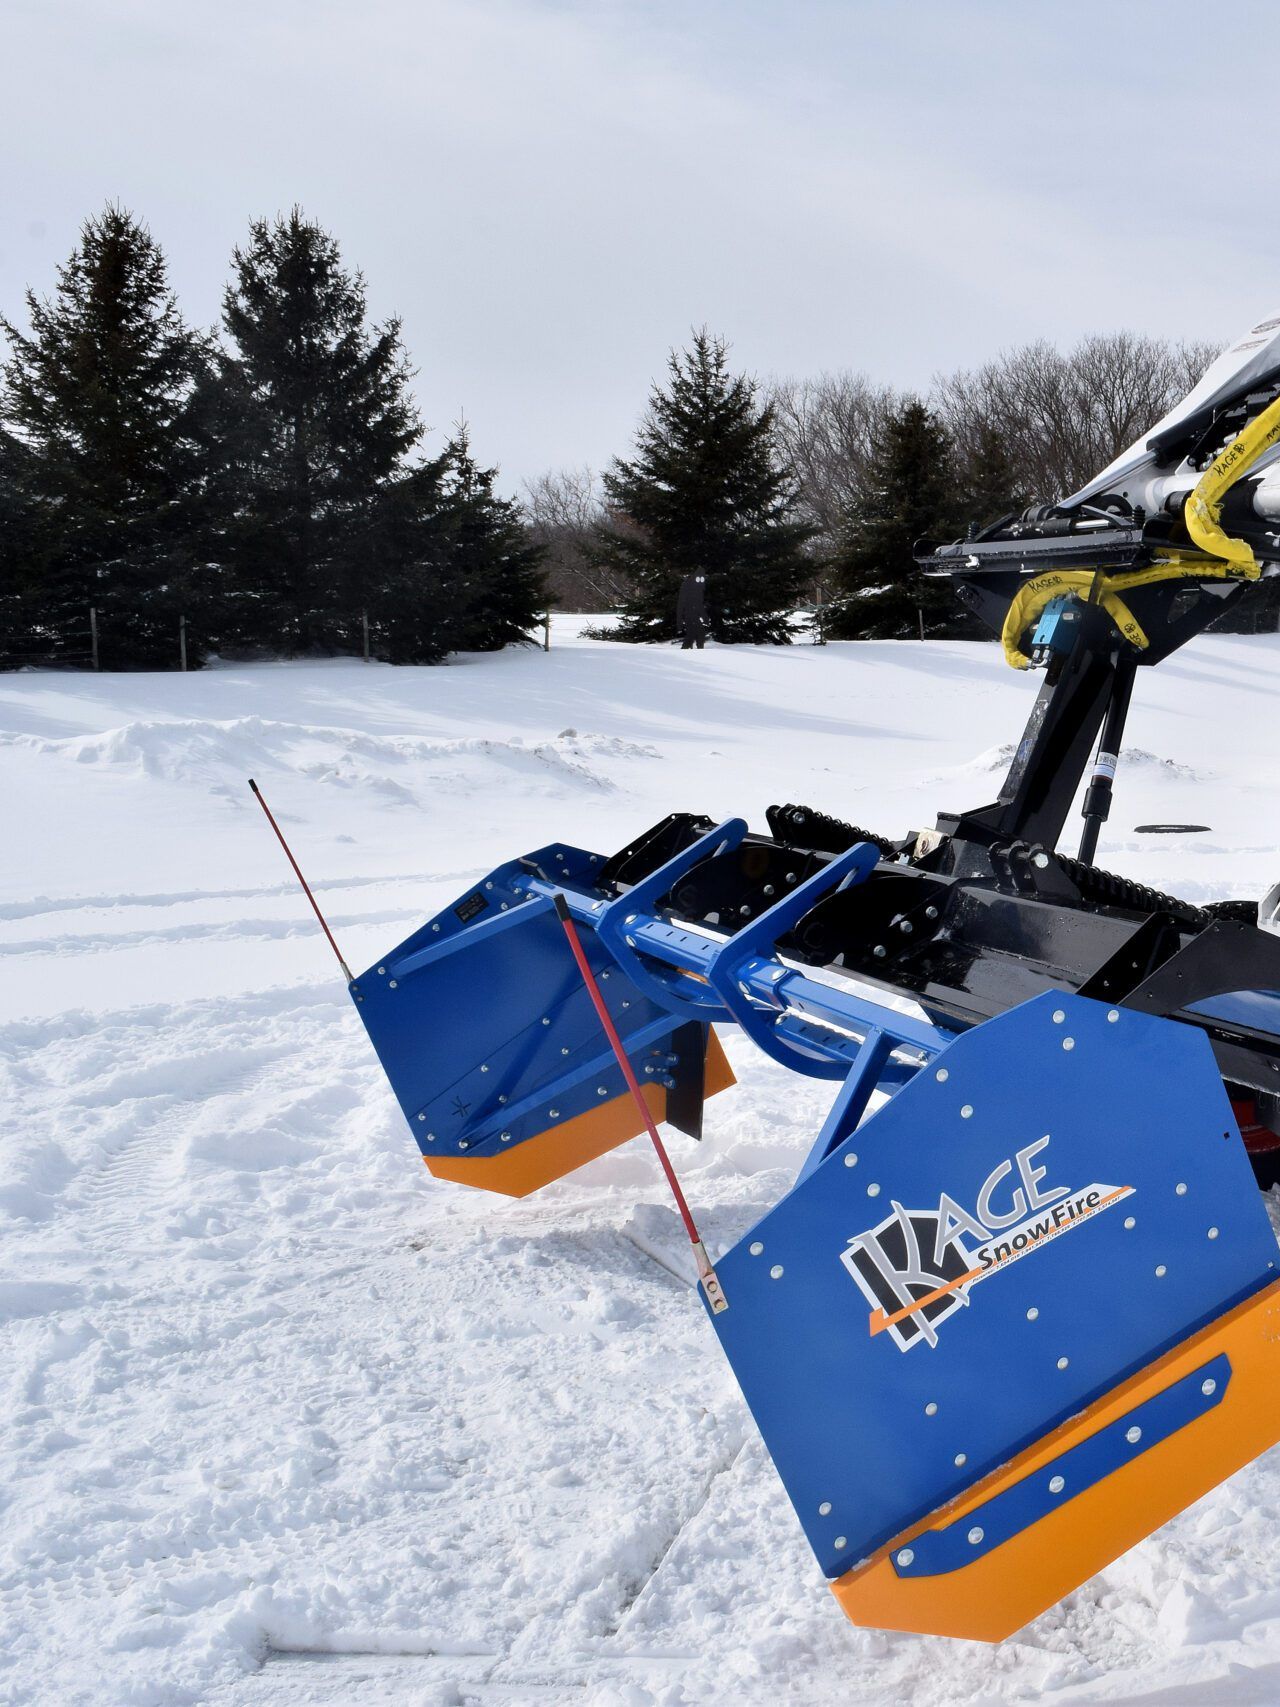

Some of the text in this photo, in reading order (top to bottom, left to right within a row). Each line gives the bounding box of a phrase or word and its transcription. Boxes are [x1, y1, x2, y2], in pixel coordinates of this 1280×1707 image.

[1213, 450, 1240, 478] KAGE
[847, 1134, 1071, 1348] KAGE
[977, 1191, 1101, 1270] SnowFire
